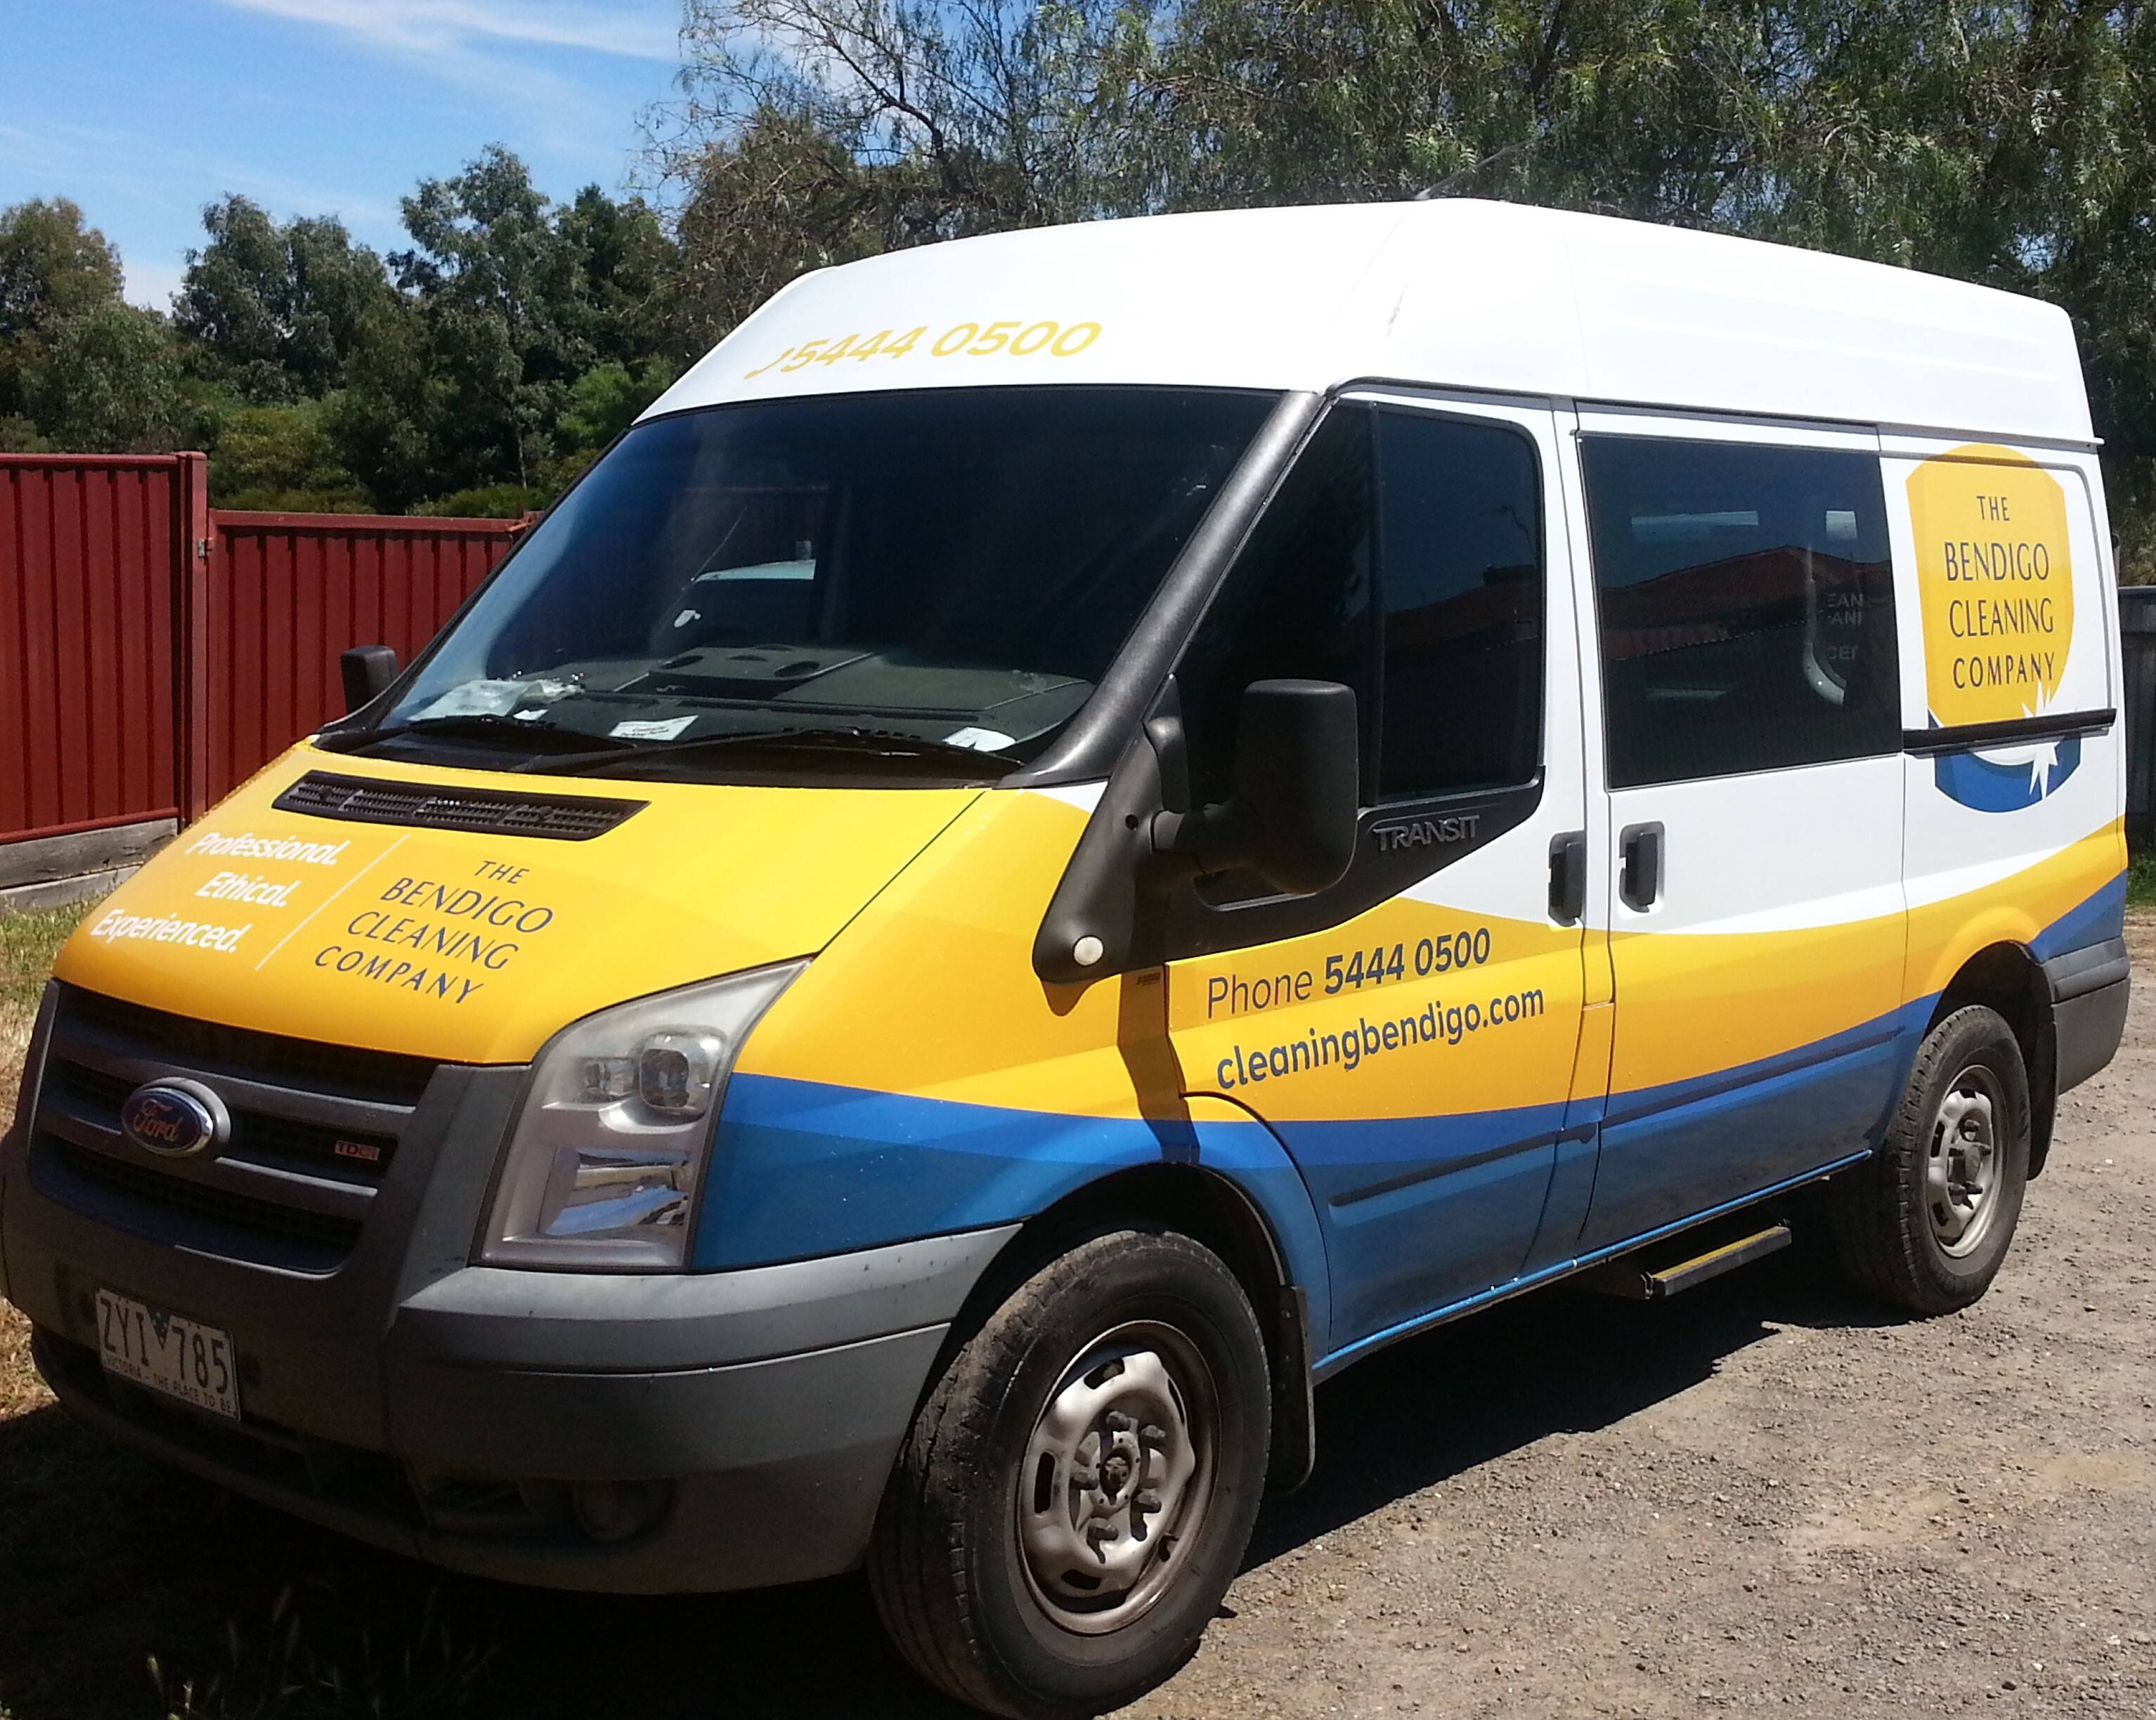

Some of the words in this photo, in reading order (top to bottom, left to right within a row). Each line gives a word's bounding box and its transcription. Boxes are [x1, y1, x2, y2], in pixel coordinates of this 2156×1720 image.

[930, 320, 1103, 357] 0500
[1977, 495, 2010, 521] THE
[1944, 542, 2049, 581] BENDIGO
[1949, 597, 2054, 638] CLEANING
[1953, 652, 2055, 689] COMPANY
[186, 832, 351, 865] Professional.
[1372, 814, 1480, 852] TRANSIT
[195, 871, 301, 908] Ethical.
[474, 860, 530, 885] THE
[380, 877, 553, 933] BENDIGO
[90, 908, 252, 953] Experienced.
[347, 911, 519, 970] CLEANING
[314, 945, 484, 1004] COMPANY
[1207, 970, 1313, 1019] Phone
[1324, 943, 1405, 994] 5444
[1415, 927, 1491, 976] 0500
[1216, 988, 1544, 1090] cleaningbendigo.com
[133, 1098, 183, 1142] Ford
